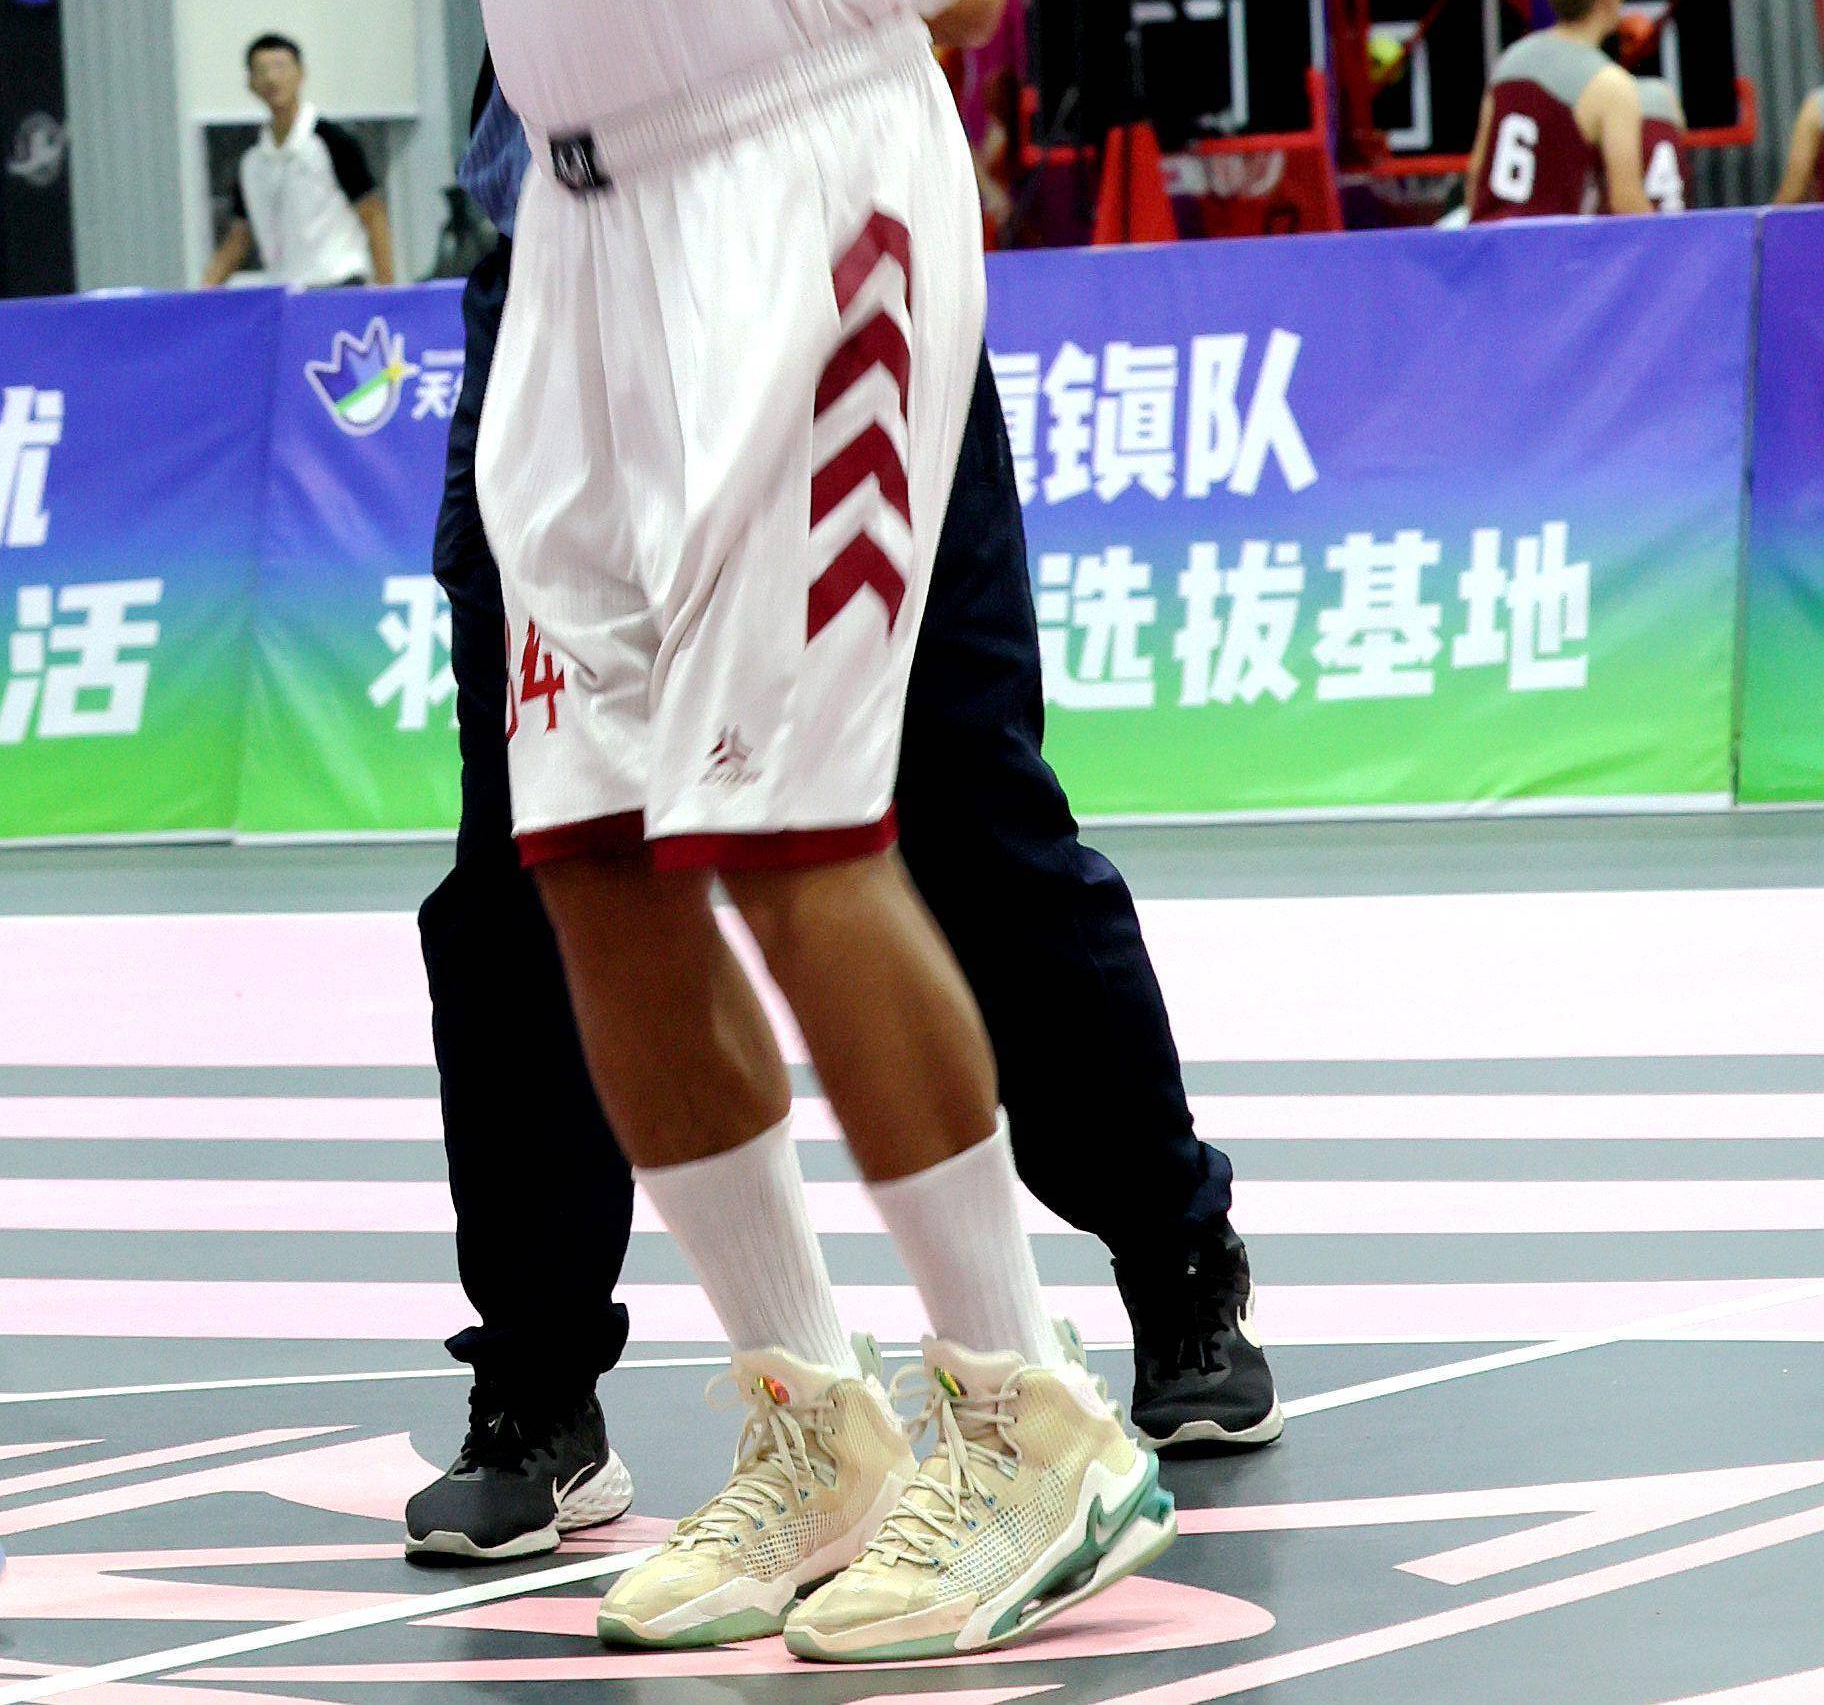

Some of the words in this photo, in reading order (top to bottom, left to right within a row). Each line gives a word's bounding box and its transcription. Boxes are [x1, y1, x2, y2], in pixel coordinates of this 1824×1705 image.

[1489, 112, 1539, 203] 6
[1038, 520, 1591, 711] 选拔基地
